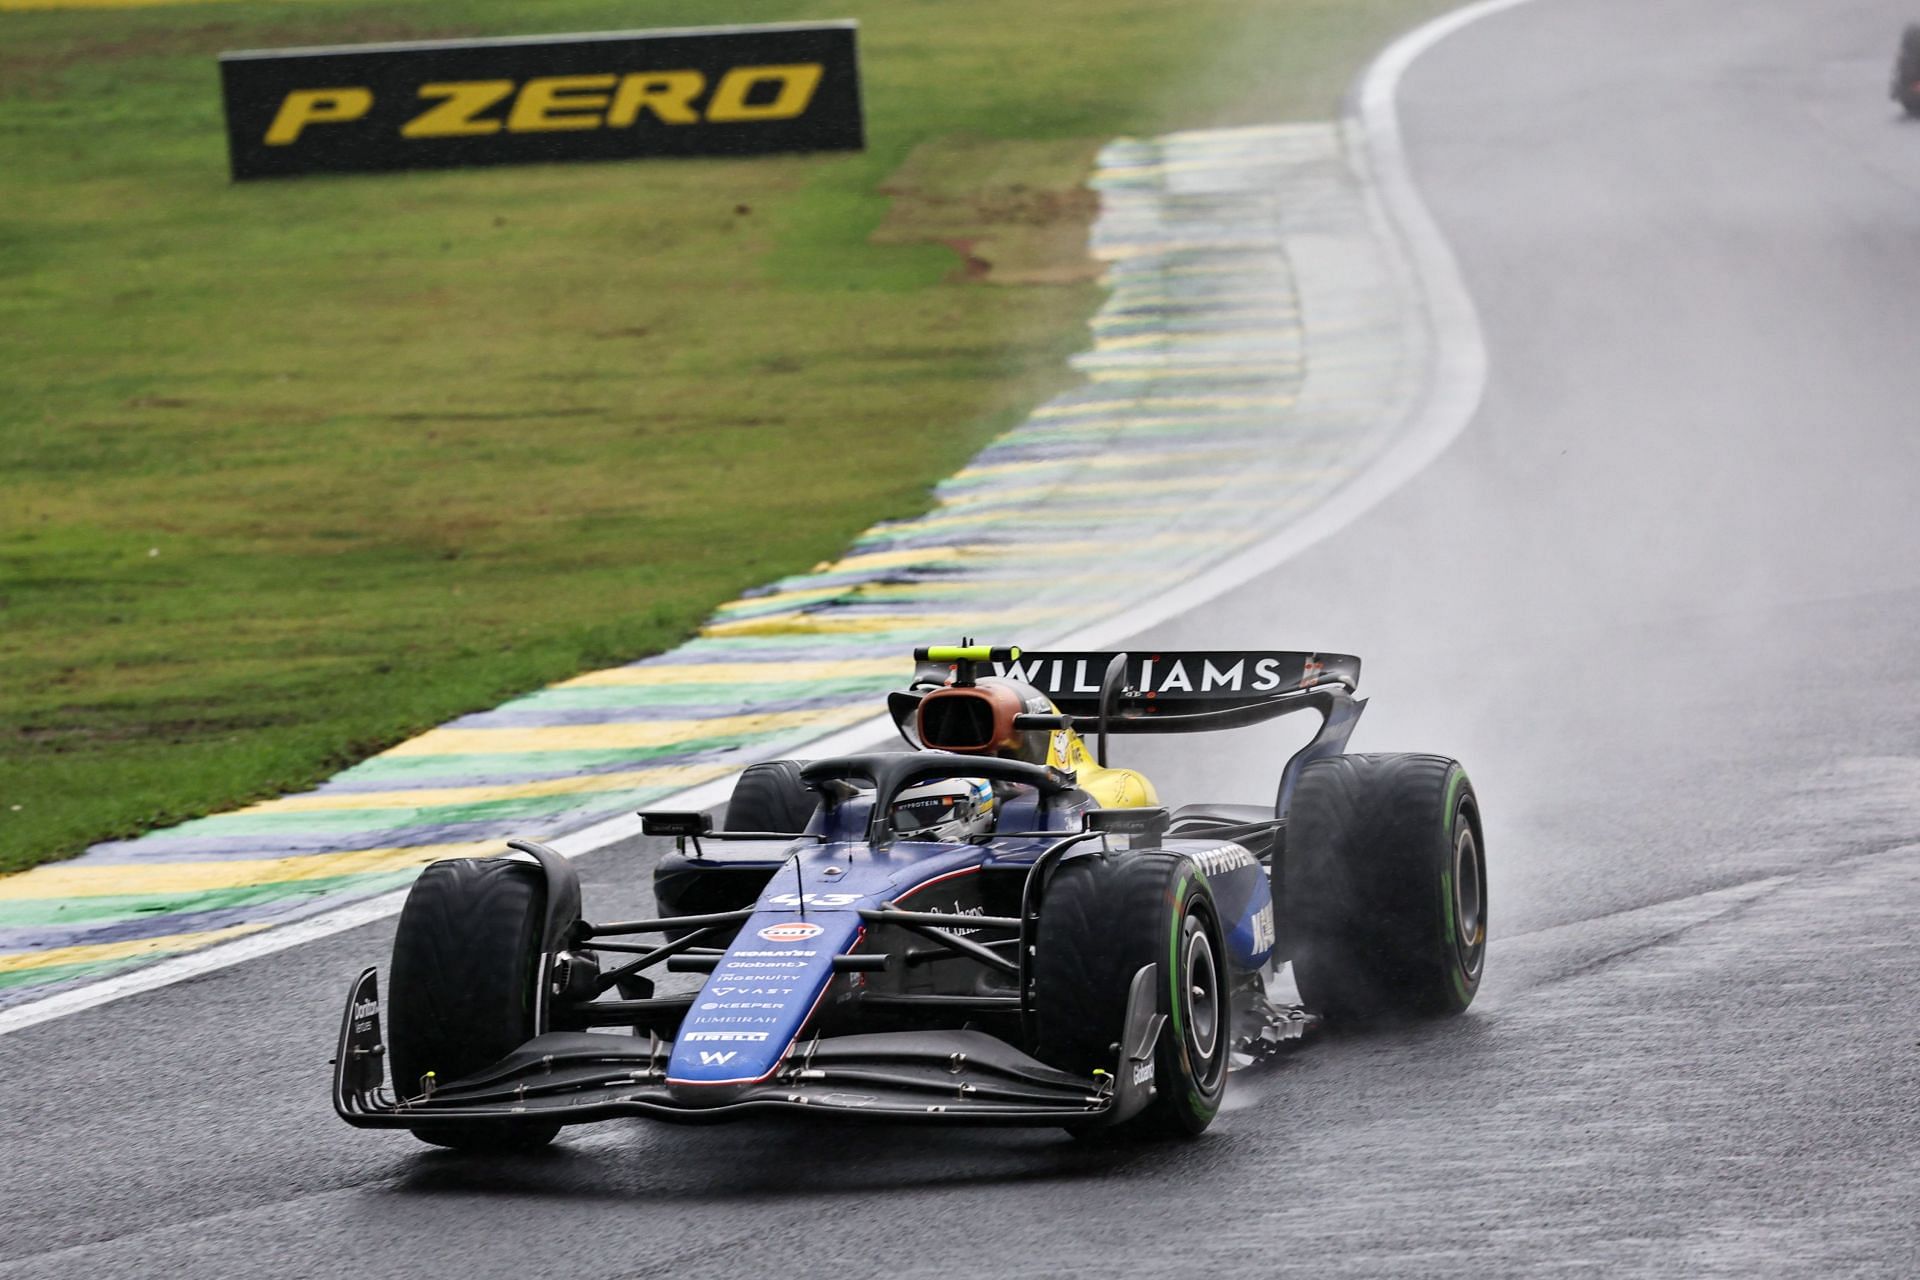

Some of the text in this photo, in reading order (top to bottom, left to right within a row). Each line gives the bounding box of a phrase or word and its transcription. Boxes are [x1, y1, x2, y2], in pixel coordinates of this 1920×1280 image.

[264, 63, 824, 146] P ZERO
[991, 658, 1281, 692] WILIAMS
[768, 894, 864, 906] 43
[683, 1031, 770, 1041] PIRELLI
[699, 1051, 738, 1065] W
